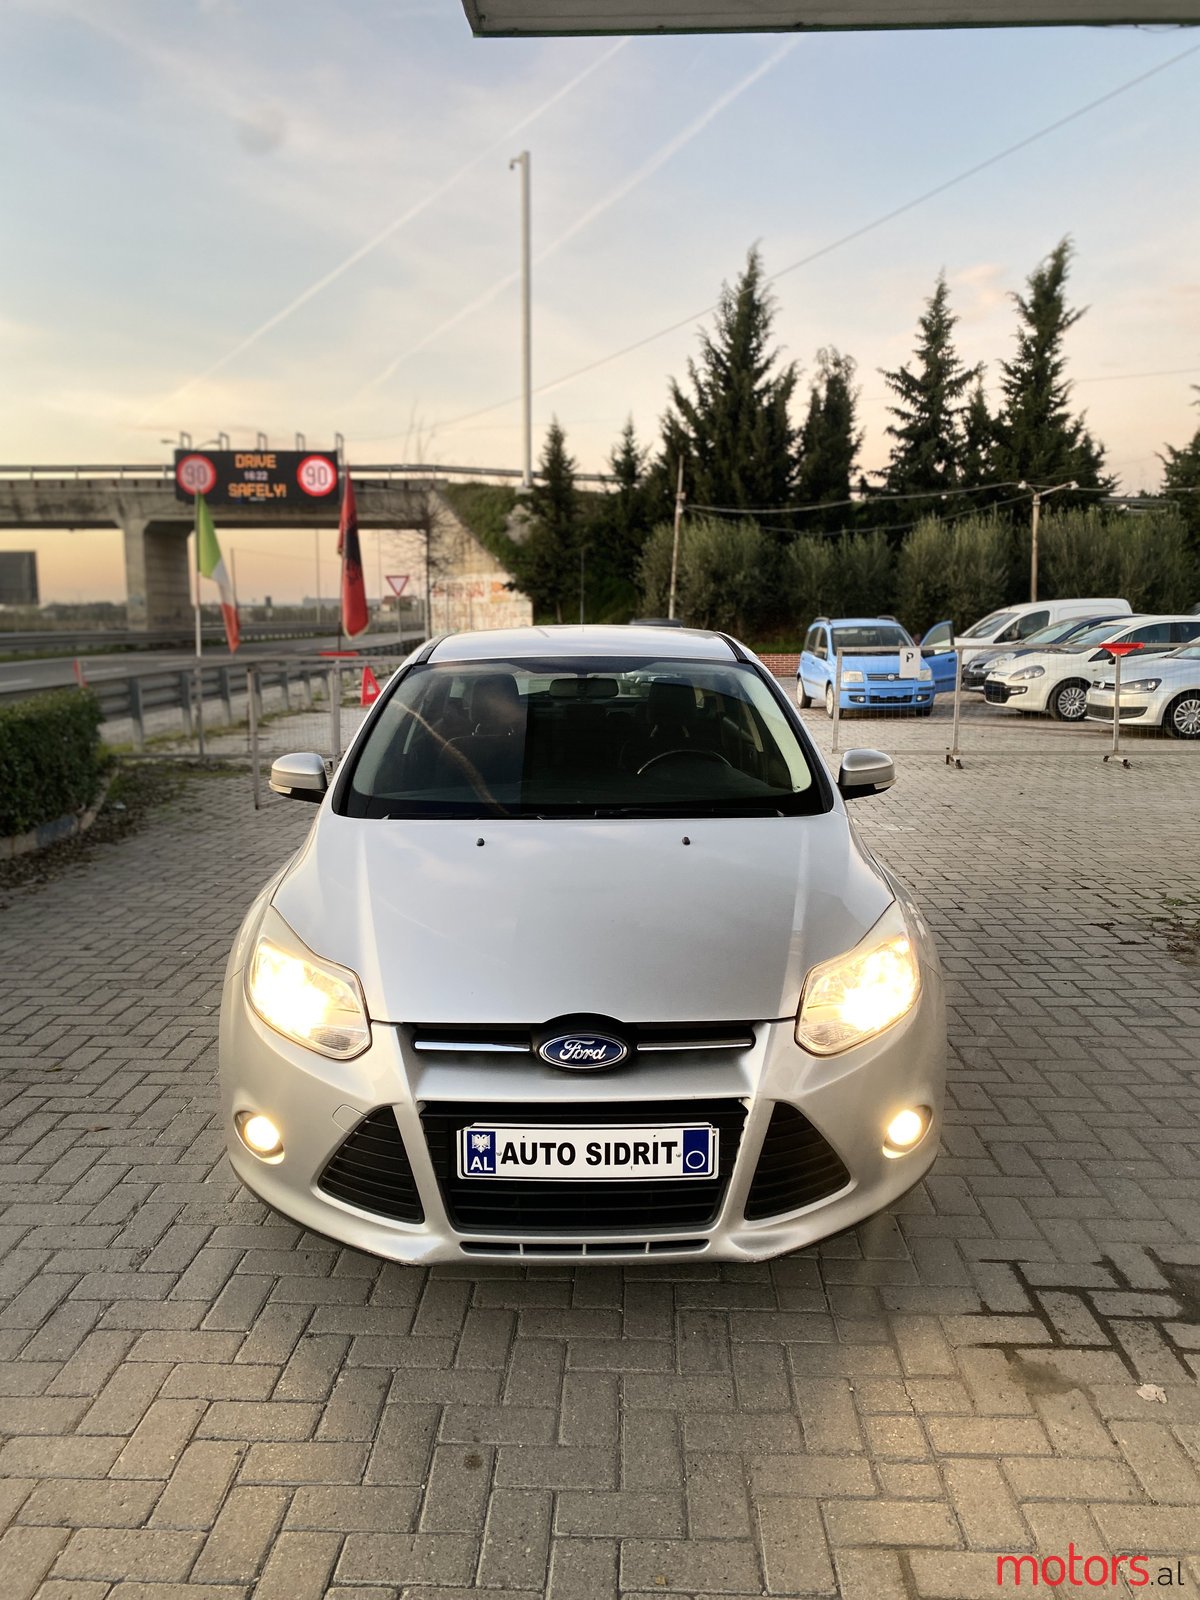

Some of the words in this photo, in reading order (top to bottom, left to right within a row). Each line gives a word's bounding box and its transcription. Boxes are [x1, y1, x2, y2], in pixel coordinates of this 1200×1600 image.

[235, 454, 276, 468] DRIVE
[184, 464, 208, 486] 90
[305, 465, 328, 486] 90
[228, 482, 287, 498] SAFELY!
[906, 652, 914, 663] P
[559, 1039, 606, 1060] Ford
[500, 1141, 576, 1165] AUTO
[585, 1141, 678, 1166] SIDRIT
[470, 1156, 493, 1171] AL
